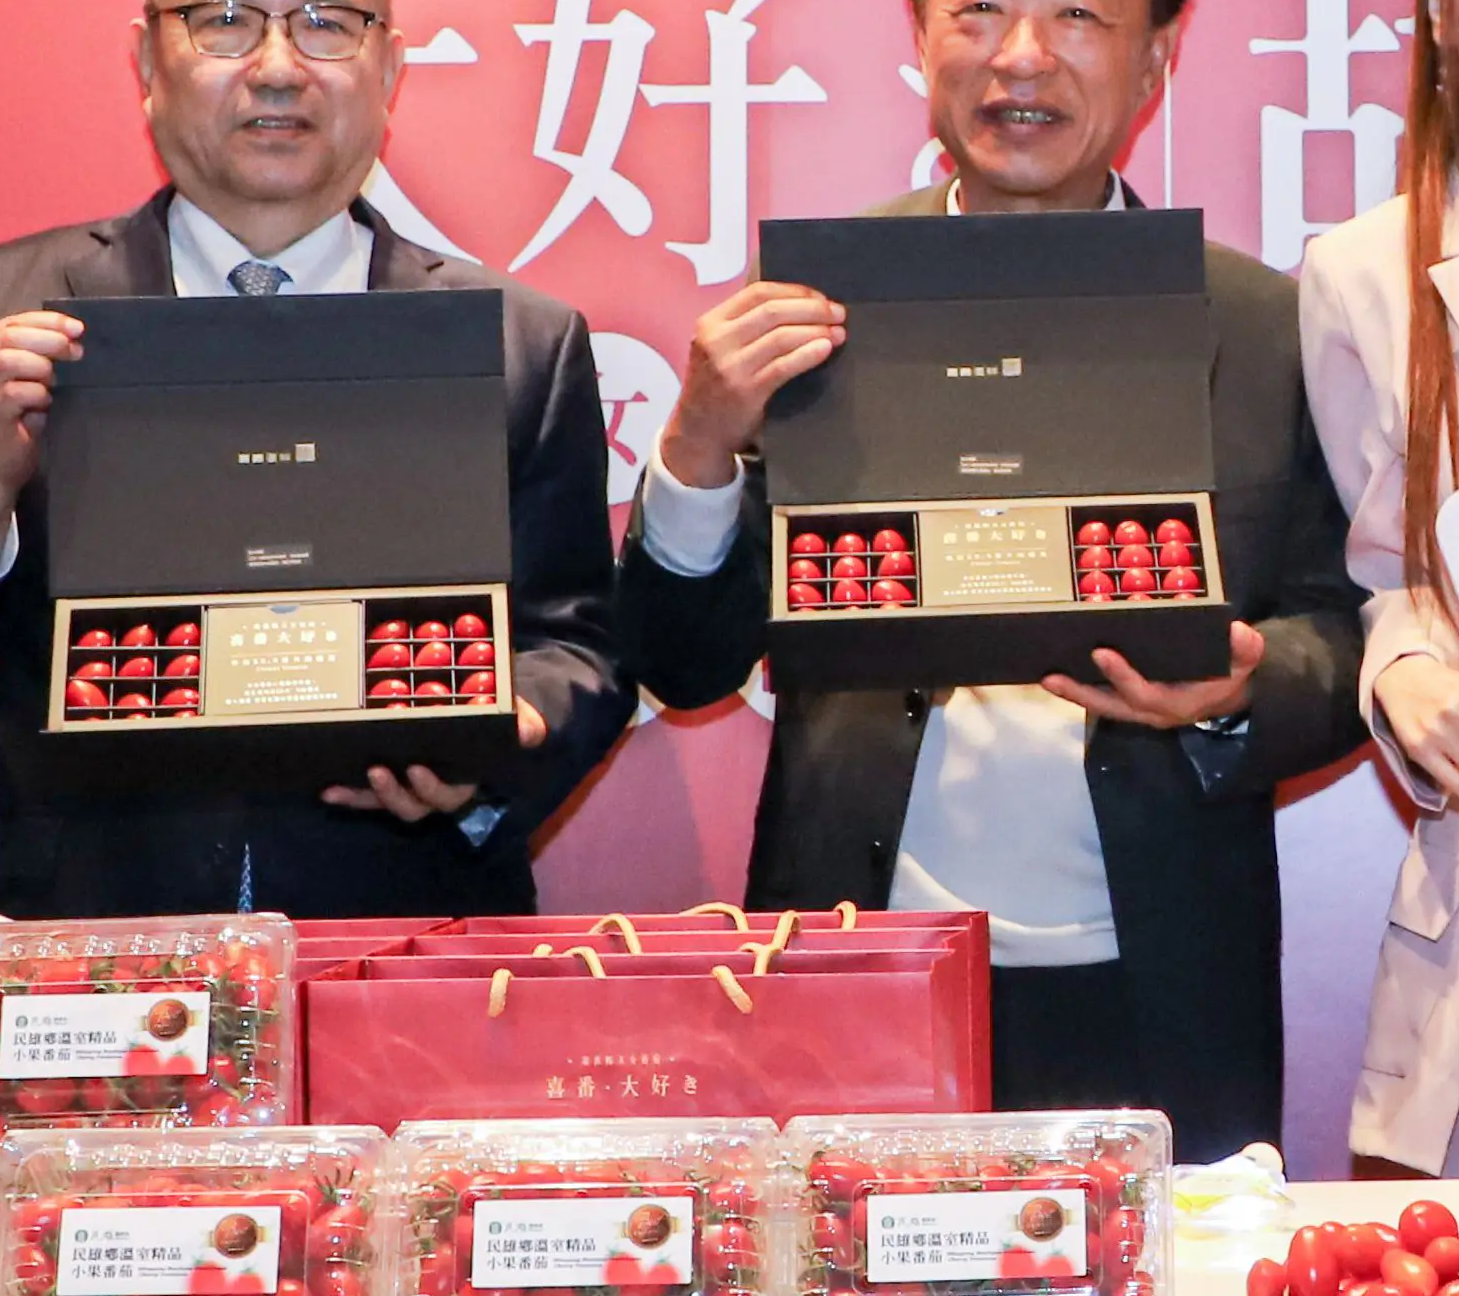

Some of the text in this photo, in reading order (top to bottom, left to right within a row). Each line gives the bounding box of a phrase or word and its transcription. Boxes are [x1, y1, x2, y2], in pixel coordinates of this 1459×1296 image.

[13, 1048, 71, 1062] 小果番茄
[486, 1256, 549, 1271] 小果番茄
[880, 1249, 943, 1266] 小果番茄
[71, 1264, 134, 1279] 小果番茄
